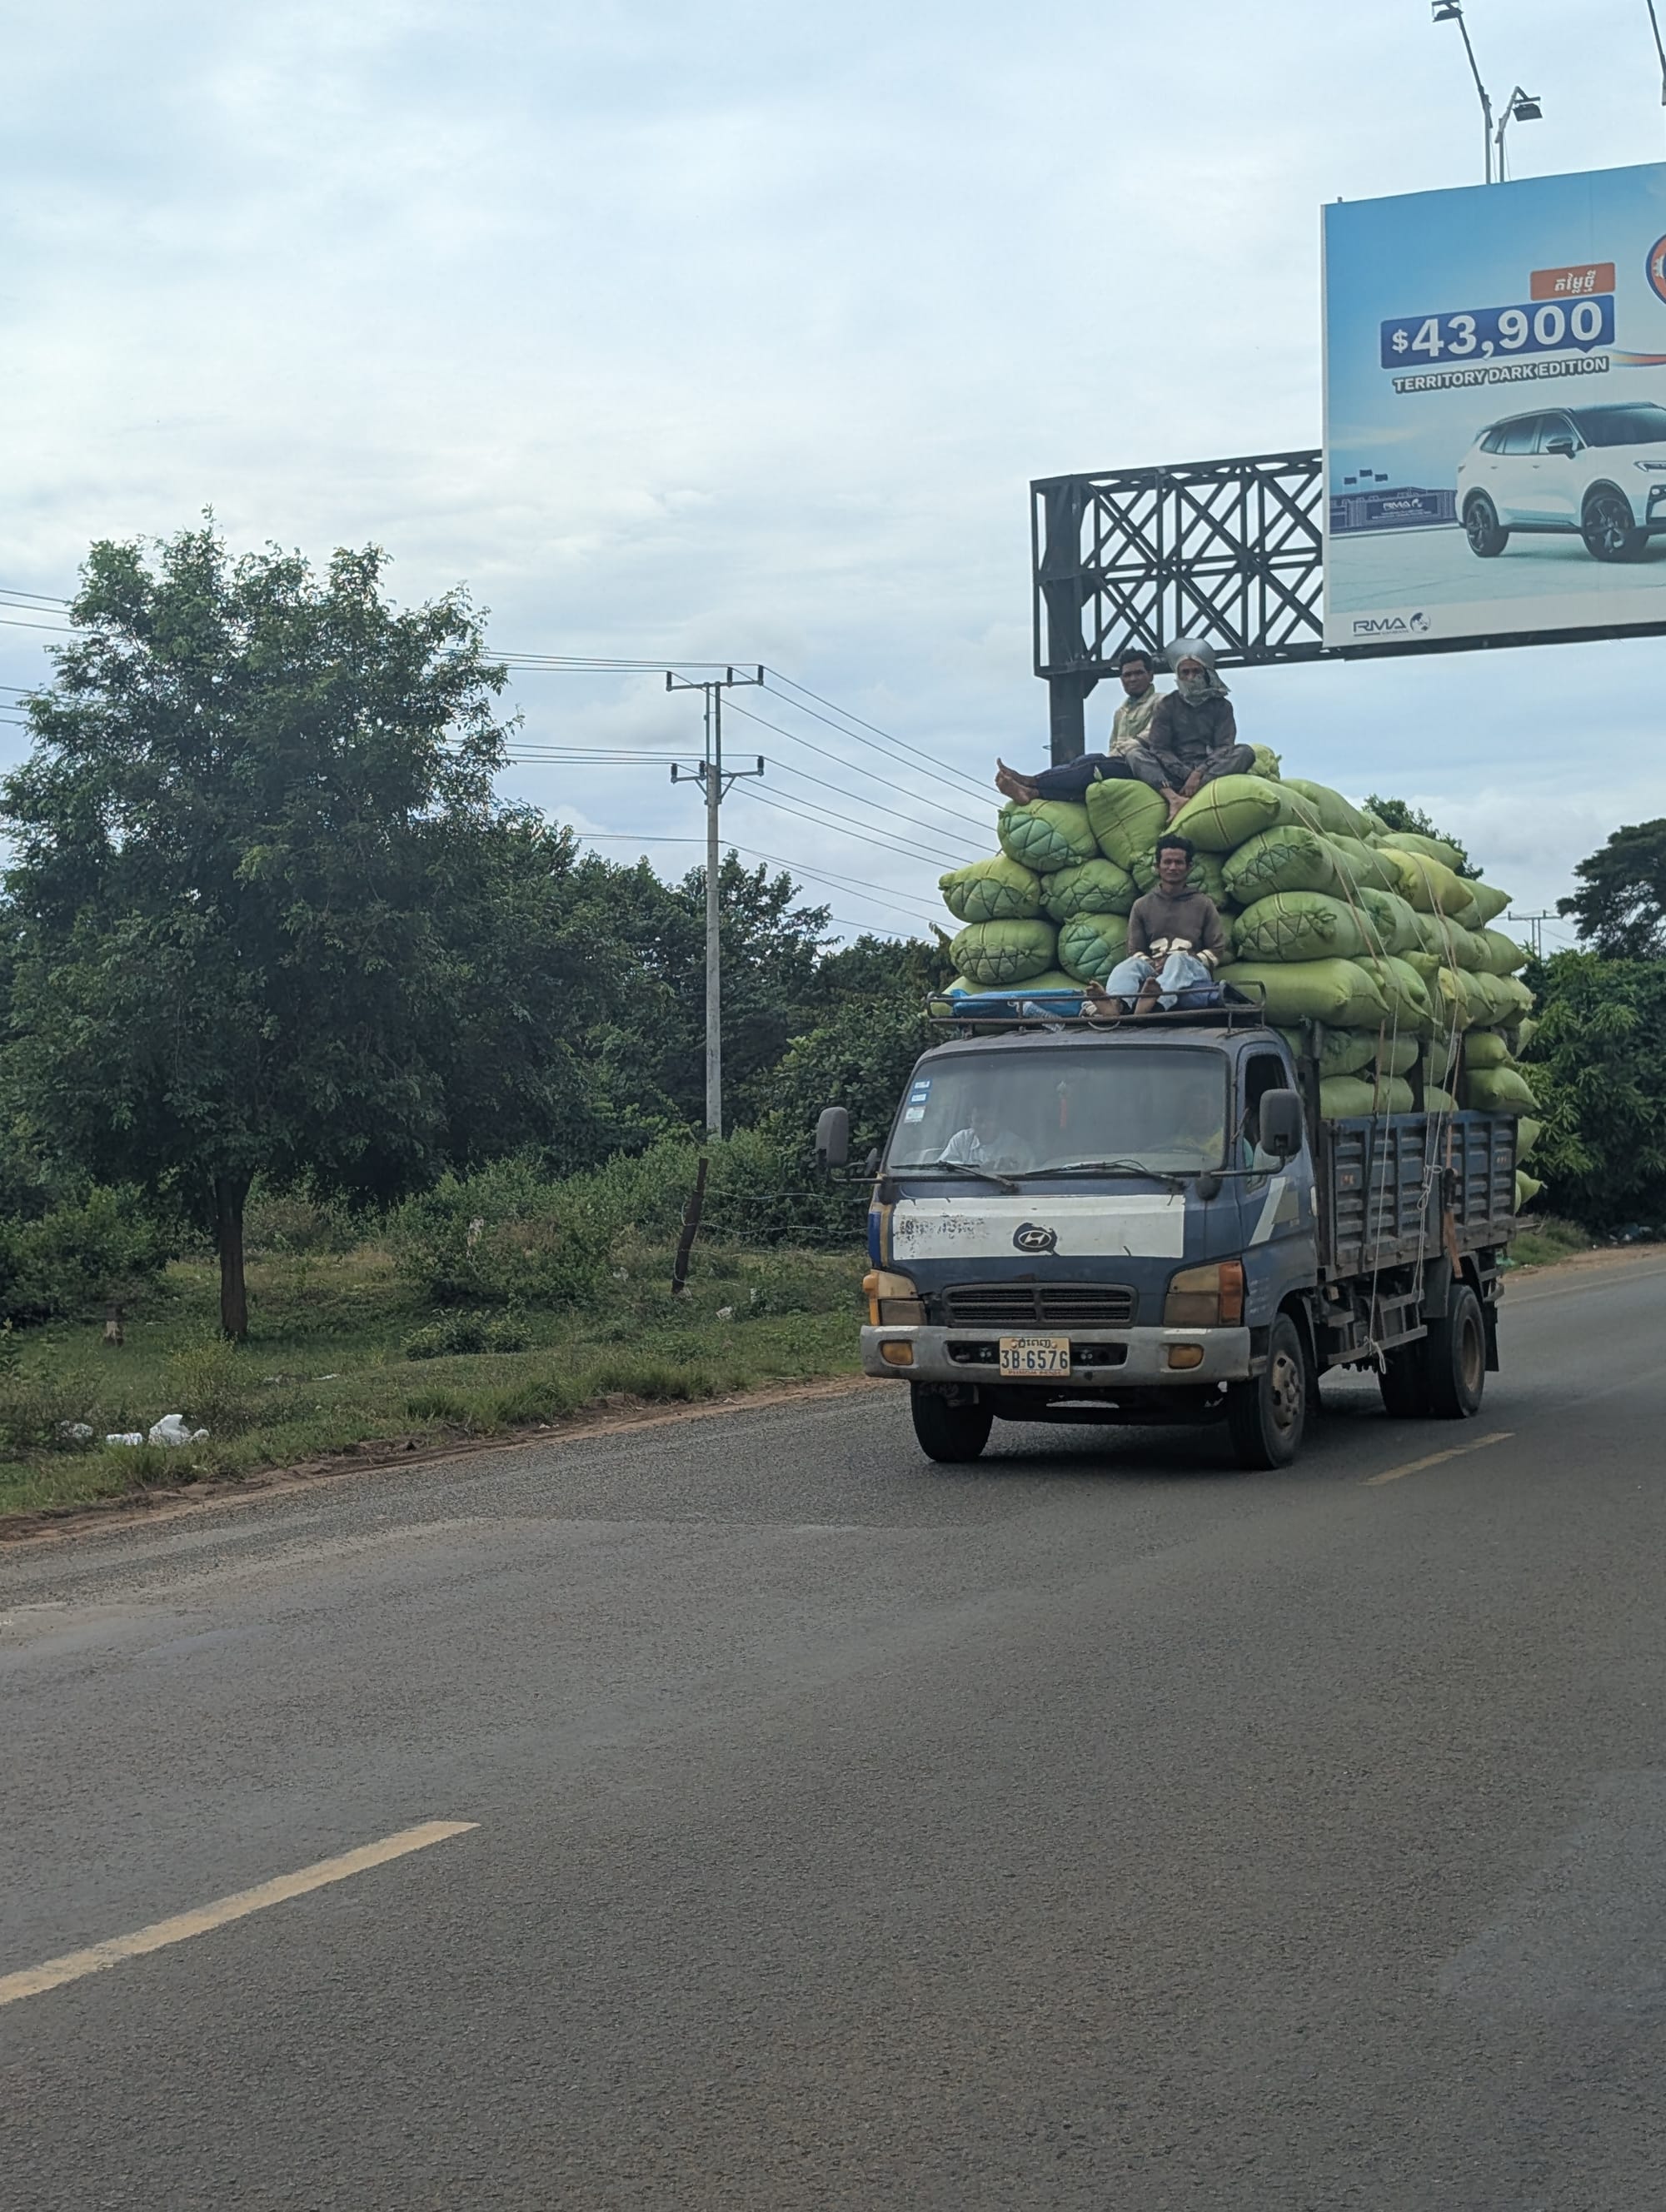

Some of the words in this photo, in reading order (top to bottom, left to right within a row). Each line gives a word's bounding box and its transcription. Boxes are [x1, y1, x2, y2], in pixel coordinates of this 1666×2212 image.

[1392, 301, 1603, 361] $43,900
[1394, 370, 1486, 392] TERRITORY
[1489, 365, 1537, 382] DARK
[1539, 357, 1607, 376] EDITION
[1353, 617, 1407, 633] RMA
[1001, 1350, 1068, 1369] 3B-6576
